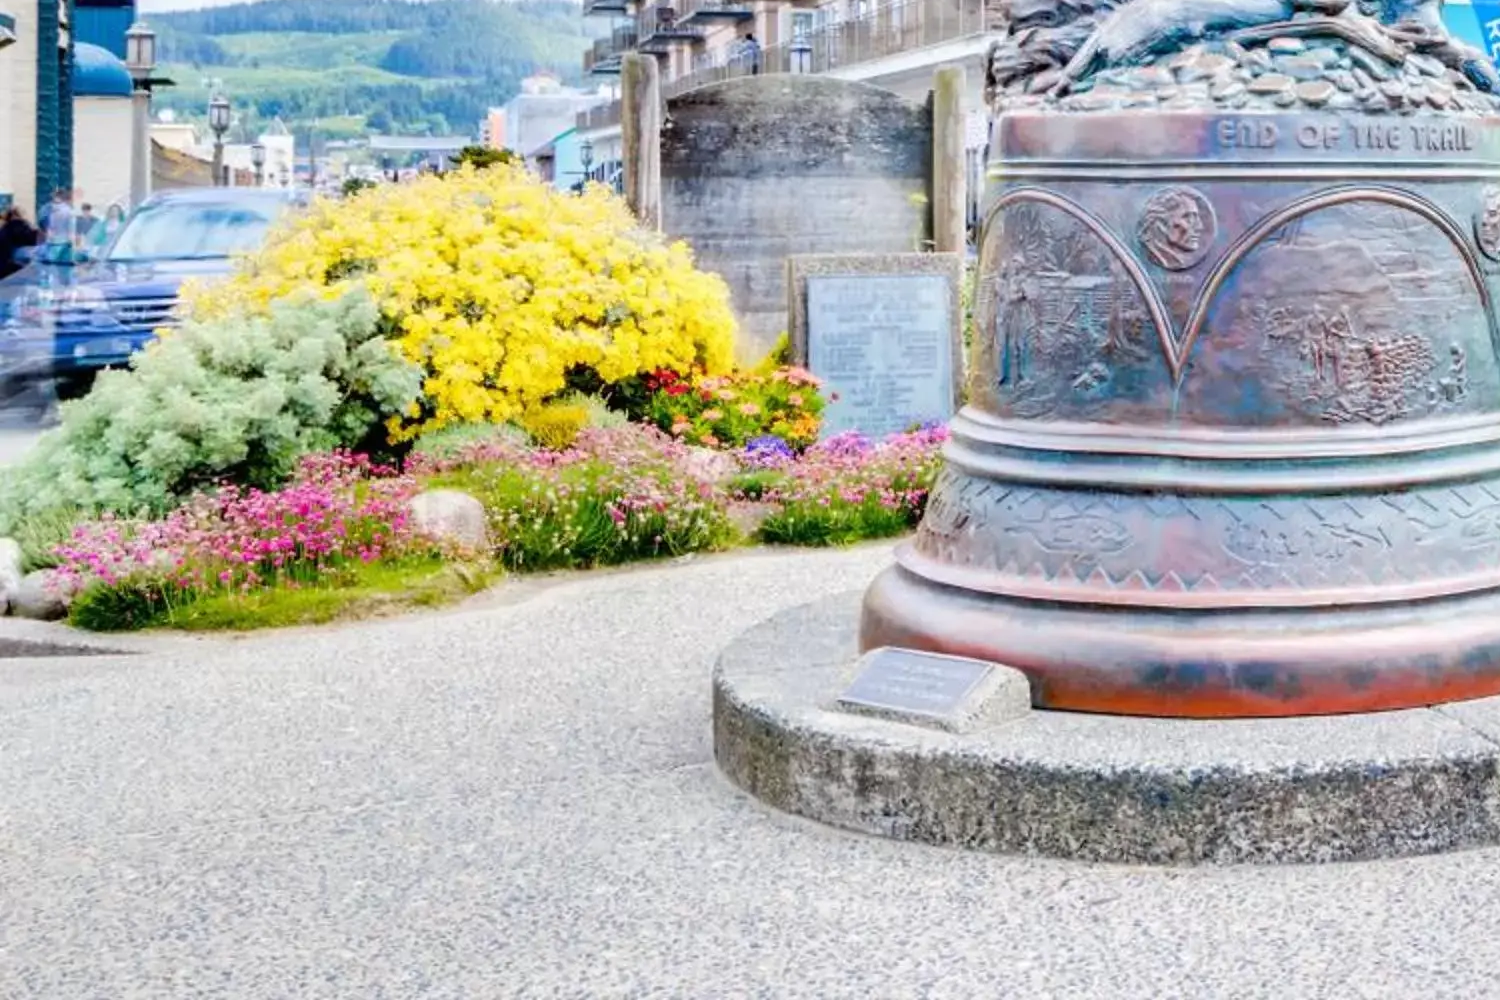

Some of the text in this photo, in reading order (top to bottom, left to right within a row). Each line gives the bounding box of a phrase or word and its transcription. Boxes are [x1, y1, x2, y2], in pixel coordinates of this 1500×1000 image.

[1296, 124, 1340, 150] OF
[1351, 123, 1400, 151] THE
[1410, 125, 1473, 151] TRAIL
